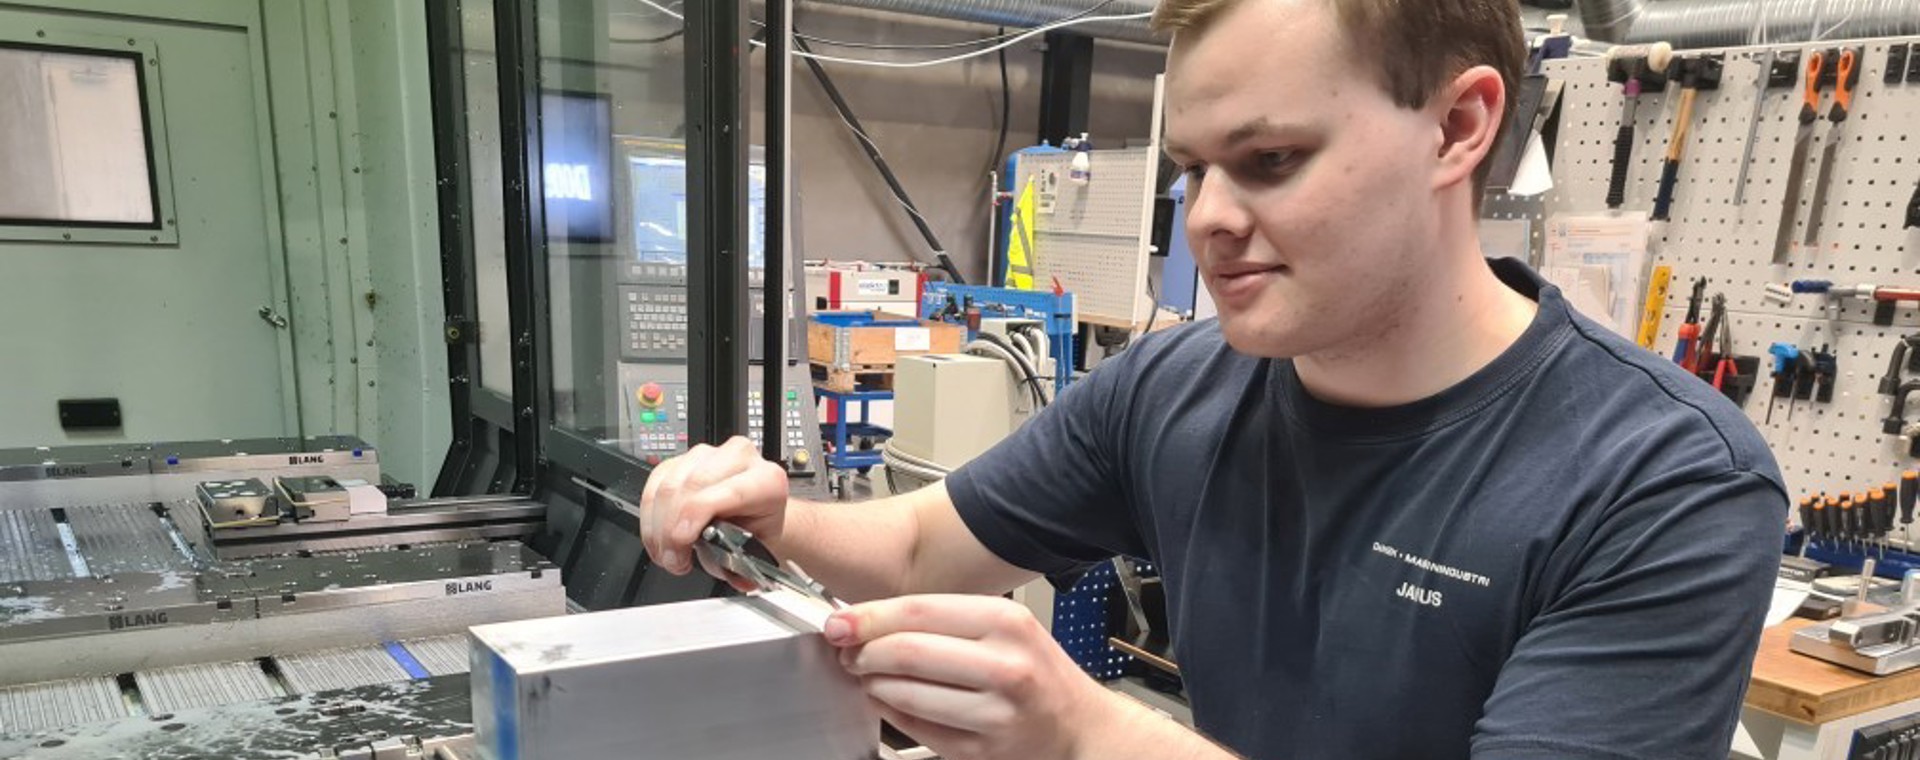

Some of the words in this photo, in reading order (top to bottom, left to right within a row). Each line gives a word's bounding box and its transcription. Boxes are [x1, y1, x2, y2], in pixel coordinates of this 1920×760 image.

[299, 455, 324, 465] LANG
[57, 465, 88, 477] LANG
[458, 580, 492, 593] LANG
[124, 612, 168, 627] LANG
